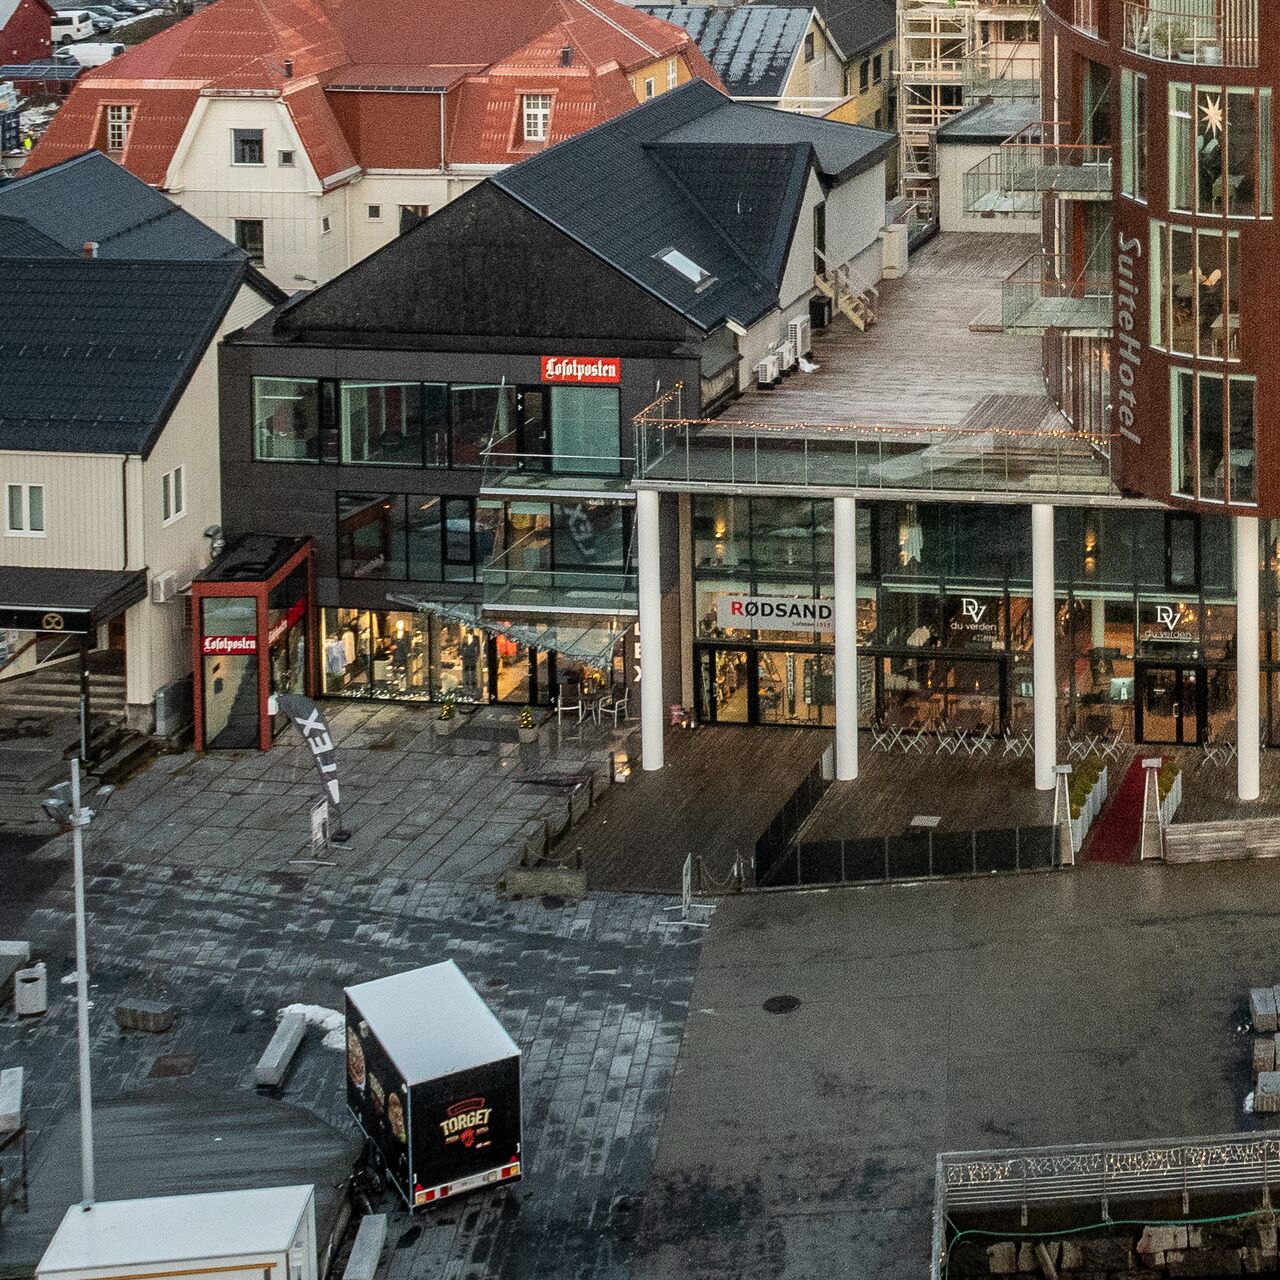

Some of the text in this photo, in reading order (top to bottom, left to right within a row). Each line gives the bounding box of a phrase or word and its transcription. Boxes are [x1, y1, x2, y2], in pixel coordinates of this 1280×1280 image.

[1118, 231, 1141, 444] SuiteHotel
[545, 358, 616, 380] Lofotposten
[731, 601, 832, 619] RØDSAND
[961, 598, 986, 623] DV
[1156, 605, 1181, 630] DV
[950, 621, 997, 631] du verden
[204, 637, 256, 653] Lofotposten
[440, 1108, 492, 1136] TORGET
